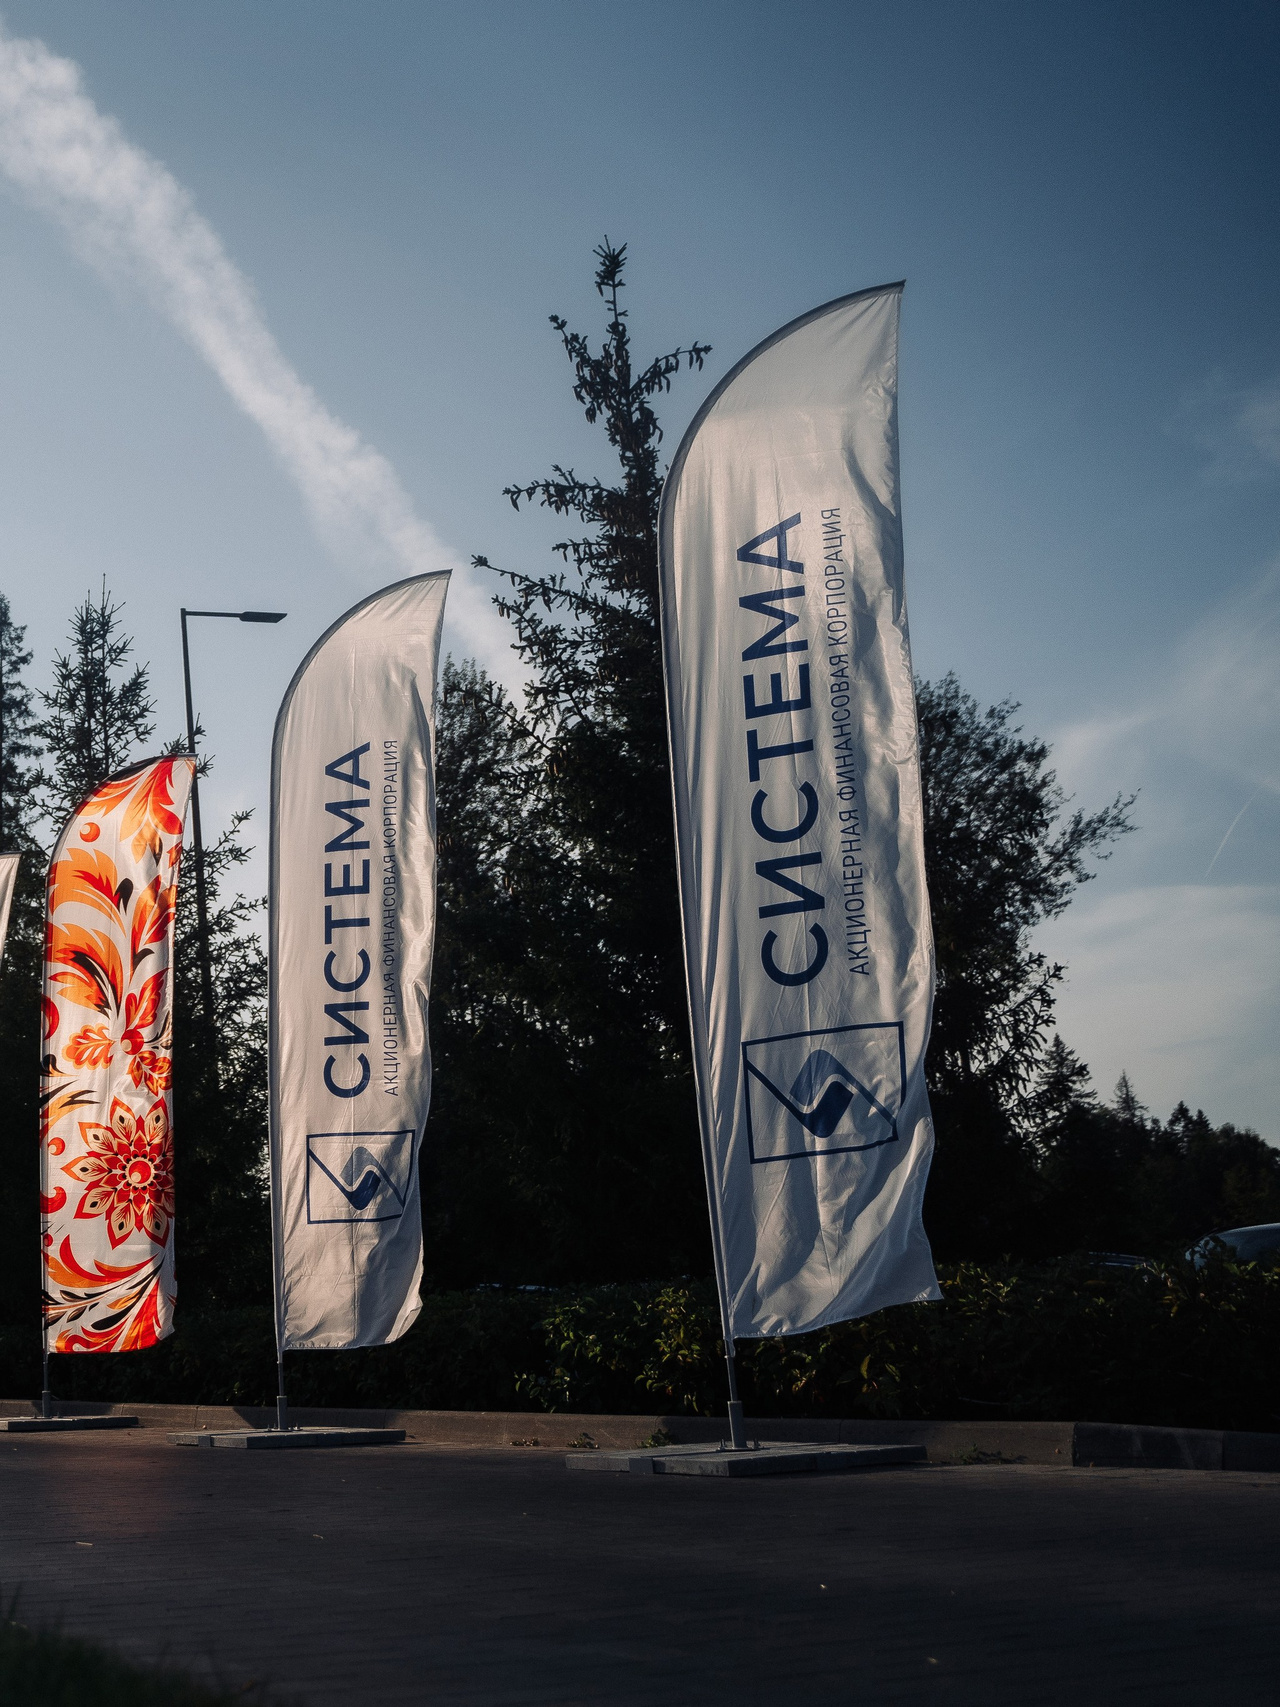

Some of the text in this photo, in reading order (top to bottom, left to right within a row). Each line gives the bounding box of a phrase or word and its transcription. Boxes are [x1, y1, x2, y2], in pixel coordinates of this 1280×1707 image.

[322, 740, 372, 1099] СИСТЕМА
[382, 740, 401, 1097] АКЦИОНЕРНАЯ ФИНАНСОВАЯ КОРПОРАЦИЯ
[736, 511, 829, 987] СИСТЕМА
[820, 507, 871, 976] АКЦИОНЕРНАЯ ФИНАНСОВАЯ КОРПОРАЦИЯ
